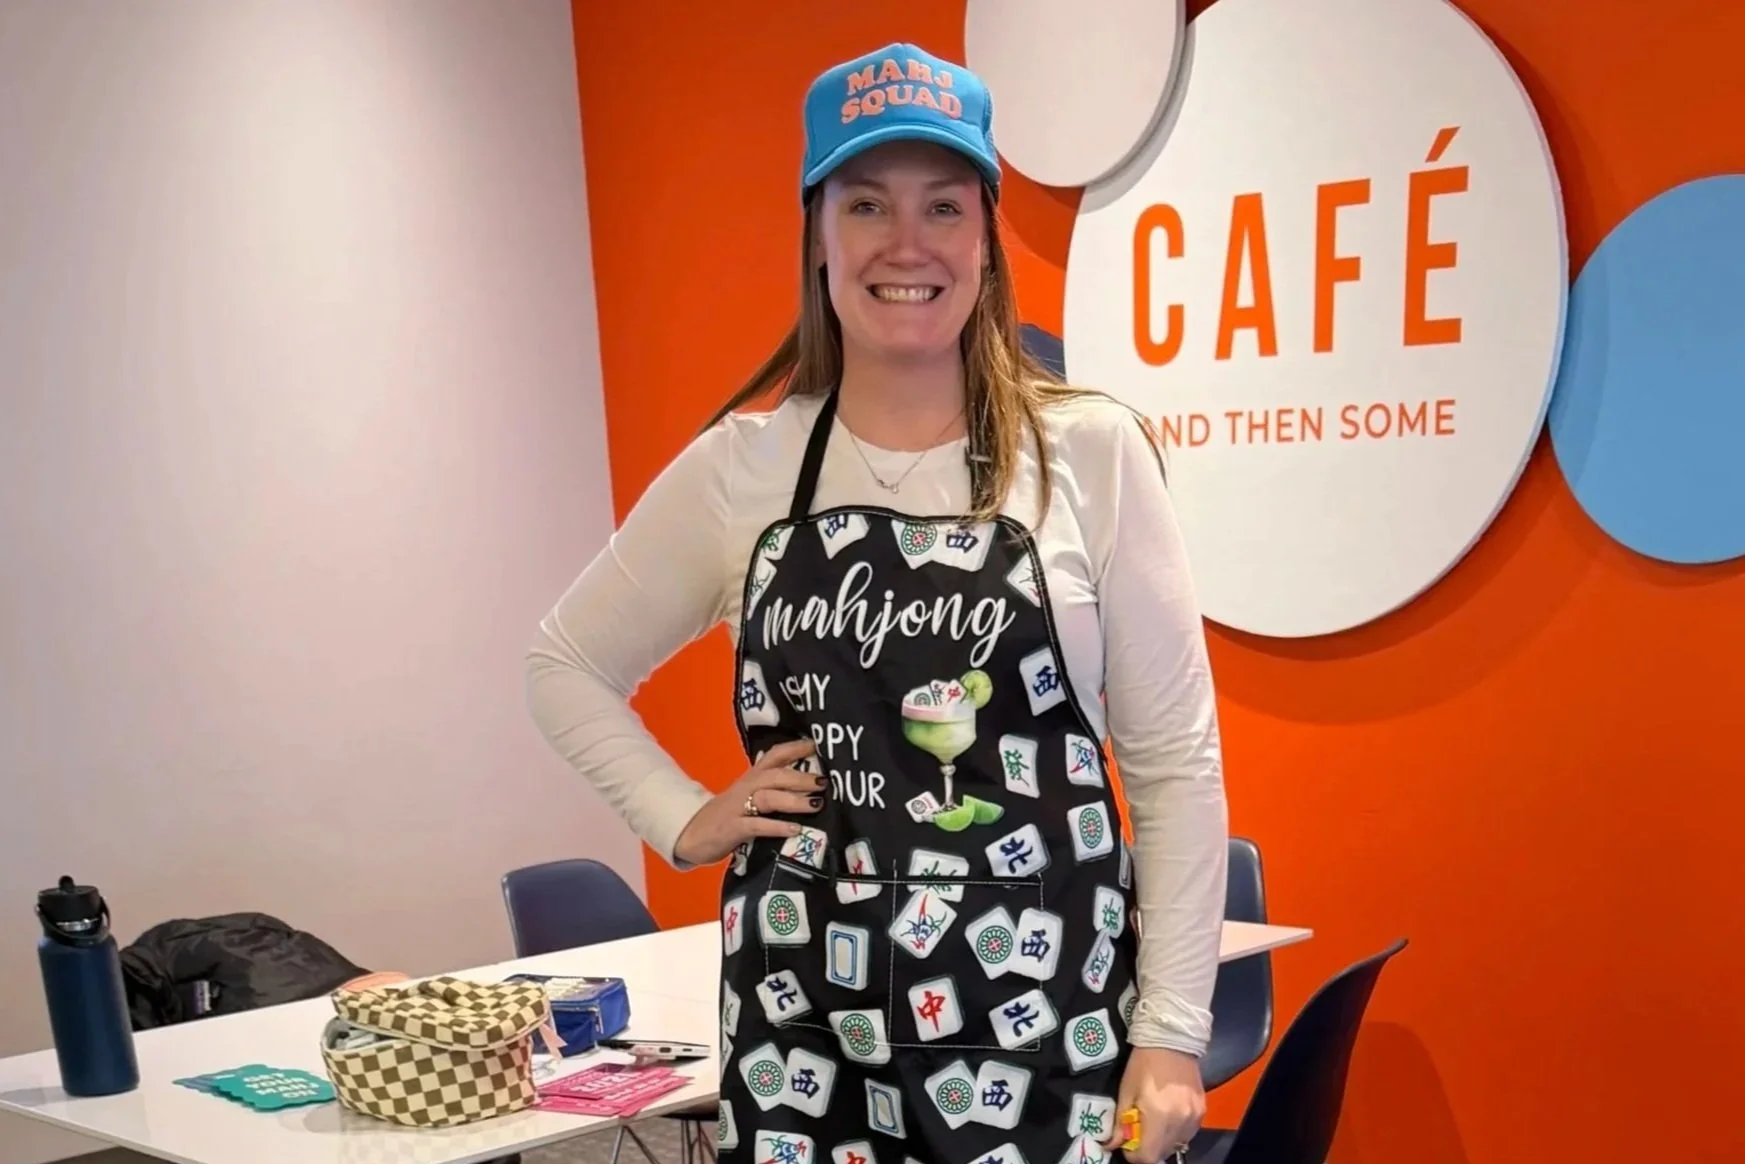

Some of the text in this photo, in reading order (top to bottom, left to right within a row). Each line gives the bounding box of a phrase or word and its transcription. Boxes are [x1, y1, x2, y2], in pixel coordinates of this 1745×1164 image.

[847, 58, 954, 95] MAHJ
[841, 85, 962, 124] SQUAD
[1133, 126, 1469, 367] CAFÉ
[1225, 407, 1323, 445] THEN
[1340, 399, 1456, 440] SOME
[763, 561, 1016, 669] mahjong
[811, 722, 864, 761] PPY
[830, 769, 886, 809] OUR
